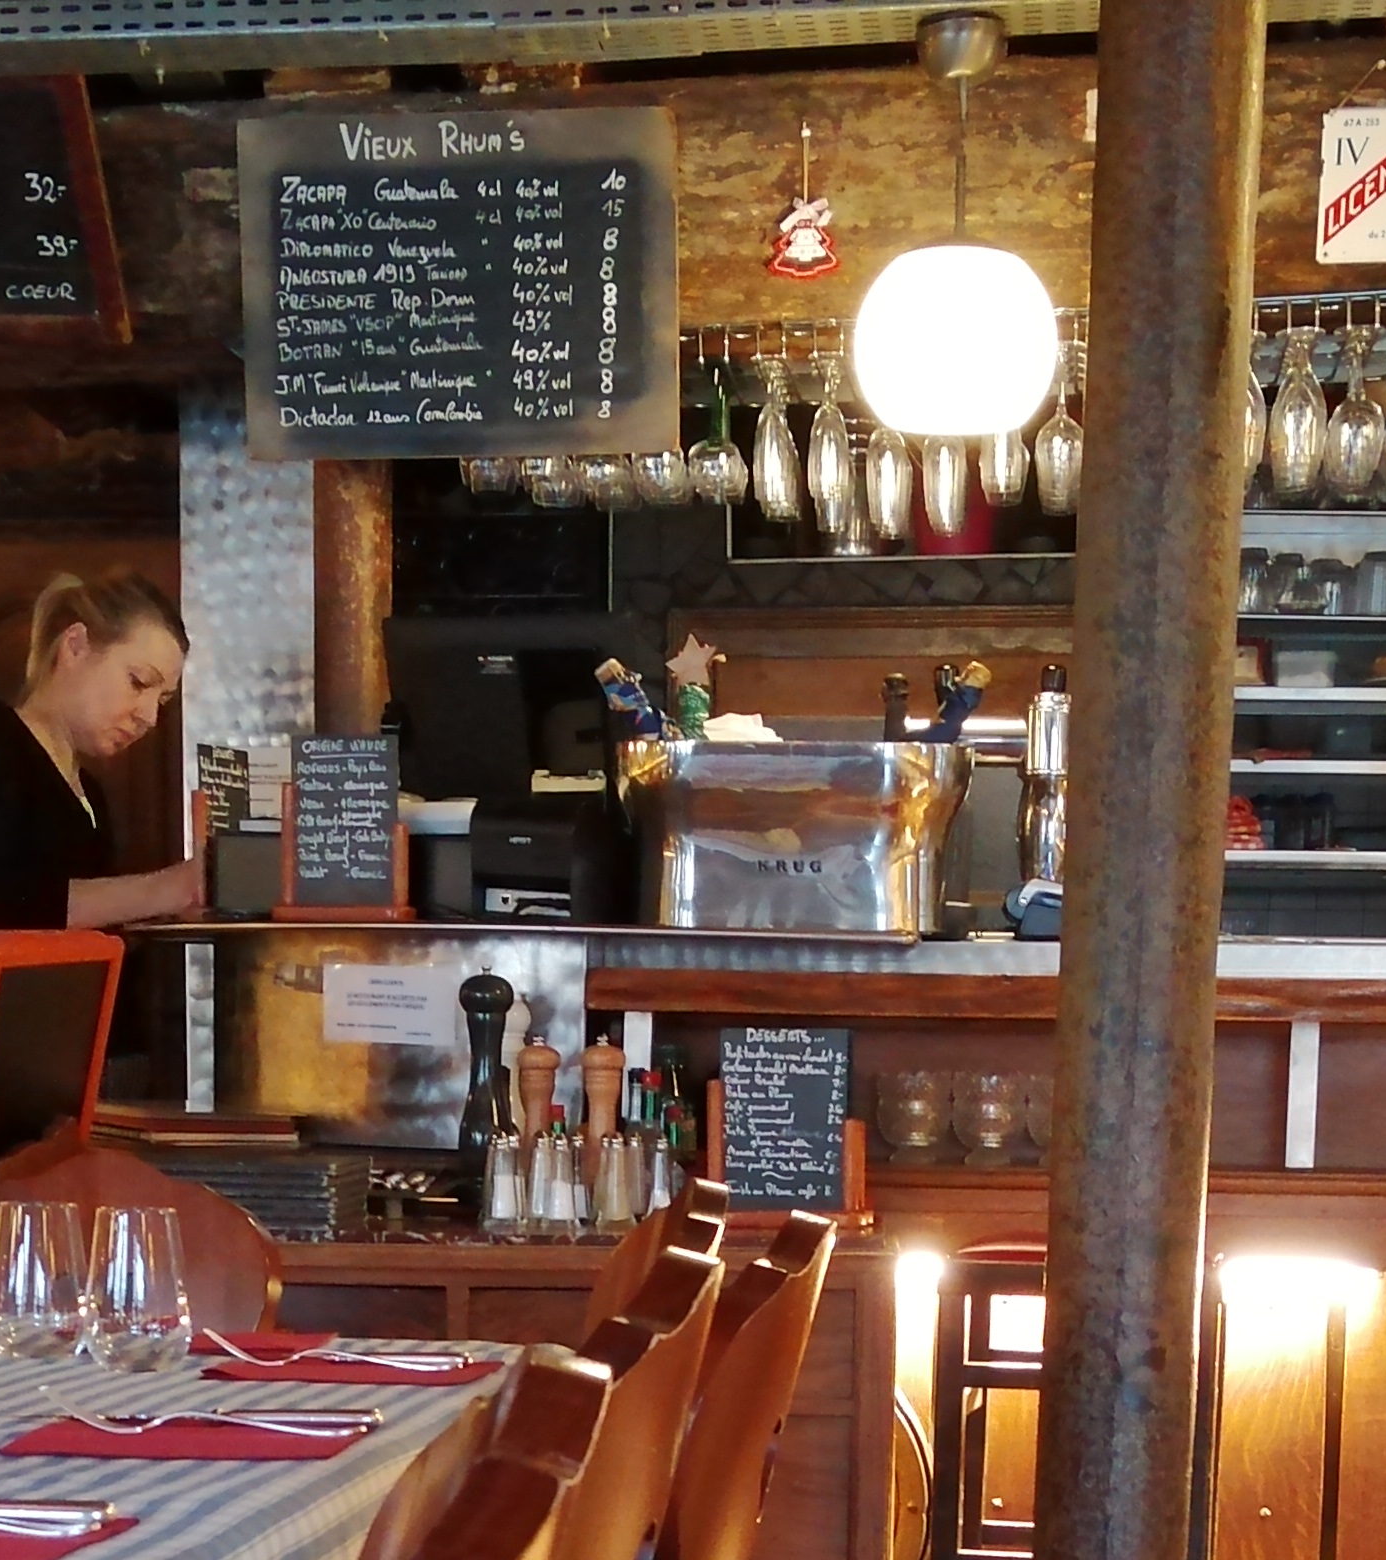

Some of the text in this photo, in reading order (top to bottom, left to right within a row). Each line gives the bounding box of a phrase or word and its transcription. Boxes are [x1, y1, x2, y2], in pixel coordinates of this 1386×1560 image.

[1336, 136, 1370, 166] IV
[279, 176, 347, 205] ZACAPA
[373, 177, 460, 202] Guatemala
[543, 180, 560, 198] vol
[601, 168, 627, 191] 10
[280, 208, 336, 232] ZACAPA
[544, 201, 563, 219] vol
[601, 198, 626, 218] 15
[280, 237, 374, 259] DIPLOMATICO
[388, 236, 458, 264] Venezuela
[545, 231, 563, 250] vol
[603, 227, 619, 251] 8
[1368, 230, 1379, 239] du
[280, 265, 368, 292] ANGOSTURA
[373, 263, 417, 284] 1919
[513, 256, 548, 276] 40%
[599, 256, 615, 281] 8
[5, 281, 77, 302] COEUR
[276, 290, 377, 311] PRESIDENTE
[513, 282, 551, 306] 40%
[554, 284, 573, 306] vol
[602, 282, 618, 307] 8
[409, 310, 478, 333] Martinique
[513, 310, 551, 337] 43%
[602, 306, 617, 334] 8
[279, 342, 343, 363] BOTRAN
[512, 339, 553, 364] 40%
[553, 341, 570, 361] vol
[598, 337, 617, 364] 8
[410, 368, 477, 397] Martinique
[513, 369, 551, 392] 49%
[552, 371, 571, 391] vol
[600, 368, 614, 394] 8
[280, 403, 358, 427] Dictador
[513, 397, 550, 420] 40%
[553, 399, 574, 418] vol
[597, 399, 612, 418] 8
[757, 860, 823, 874] KRUG
